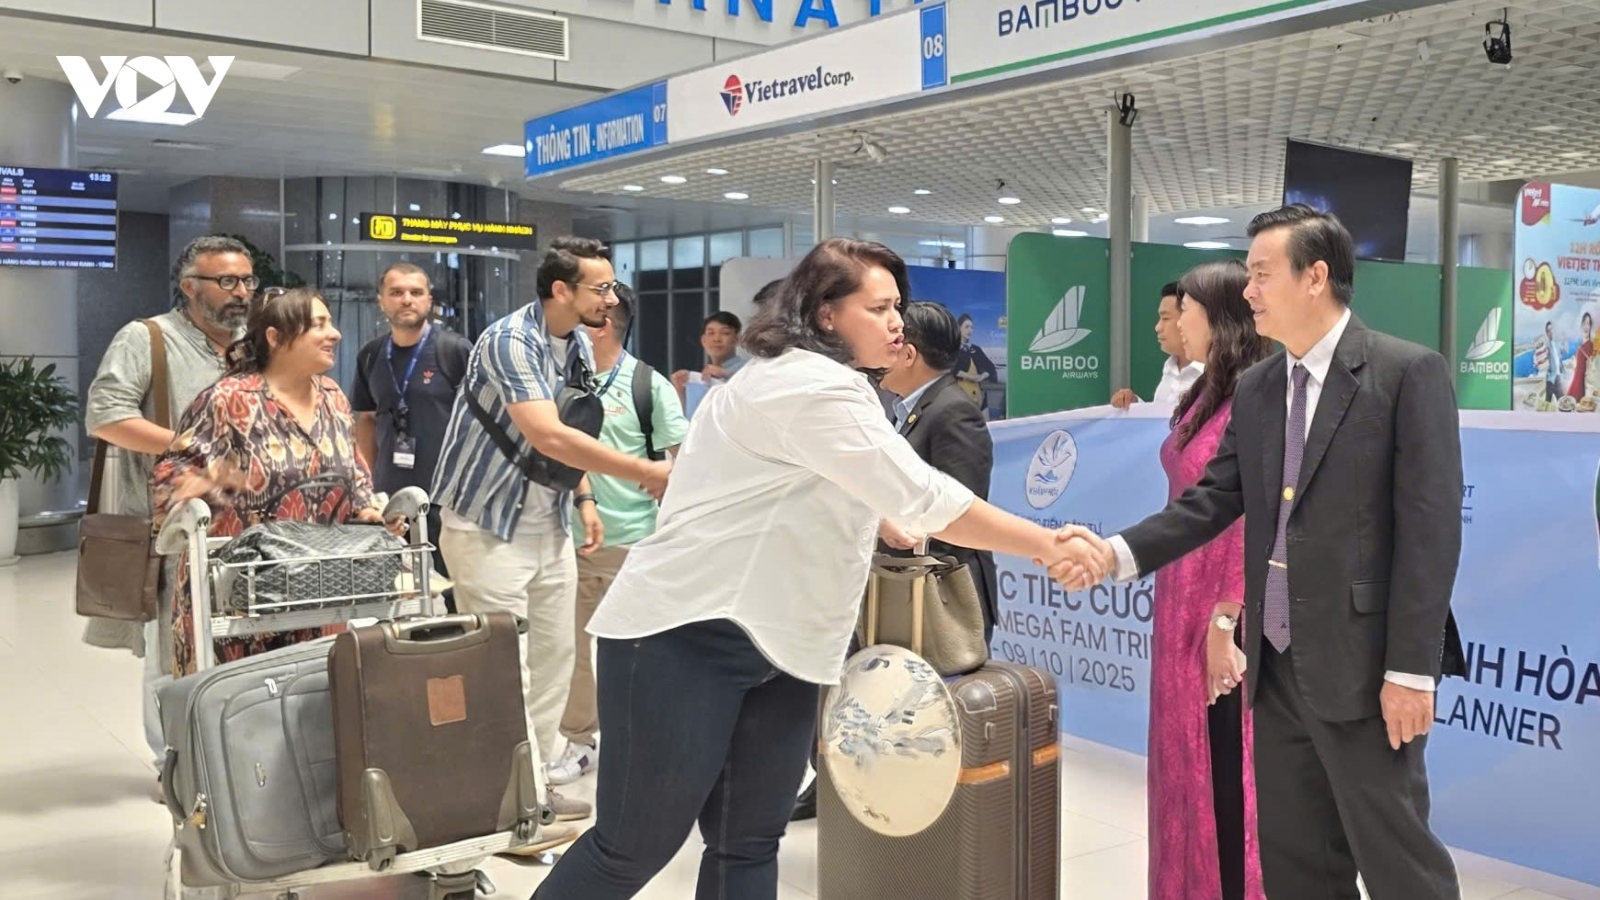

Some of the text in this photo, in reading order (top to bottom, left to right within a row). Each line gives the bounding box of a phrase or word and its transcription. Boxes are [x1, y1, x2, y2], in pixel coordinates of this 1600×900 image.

[923, 34, 943, 60] 08
[744, 66, 854, 104] Vietravel Corp.
[653, 103, 667, 123] 07
[536, 124, 571, 166] THÔNG
[572, 123, 591, 157] TIN
[596, 113, 644, 152] INFORMATION
[1021, 355, 1099, 371] BAMBOO
[1062, 371, 1099, 379] AIRWAYS
[1460, 361, 1509, 374] BAMBOO
[1089, 580, 1154, 623] CƯỚ
[999, 610, 1150, 660] MEGA FAM TRI
[1002, 640, 1027, 666] 09
[1040, 650, 1063, 676] 10
[1078, 658, 1136, 693] 2025
[1514, 645, 1600, 705] HÒA
[1433, 690, 1563, 751] LANNER
